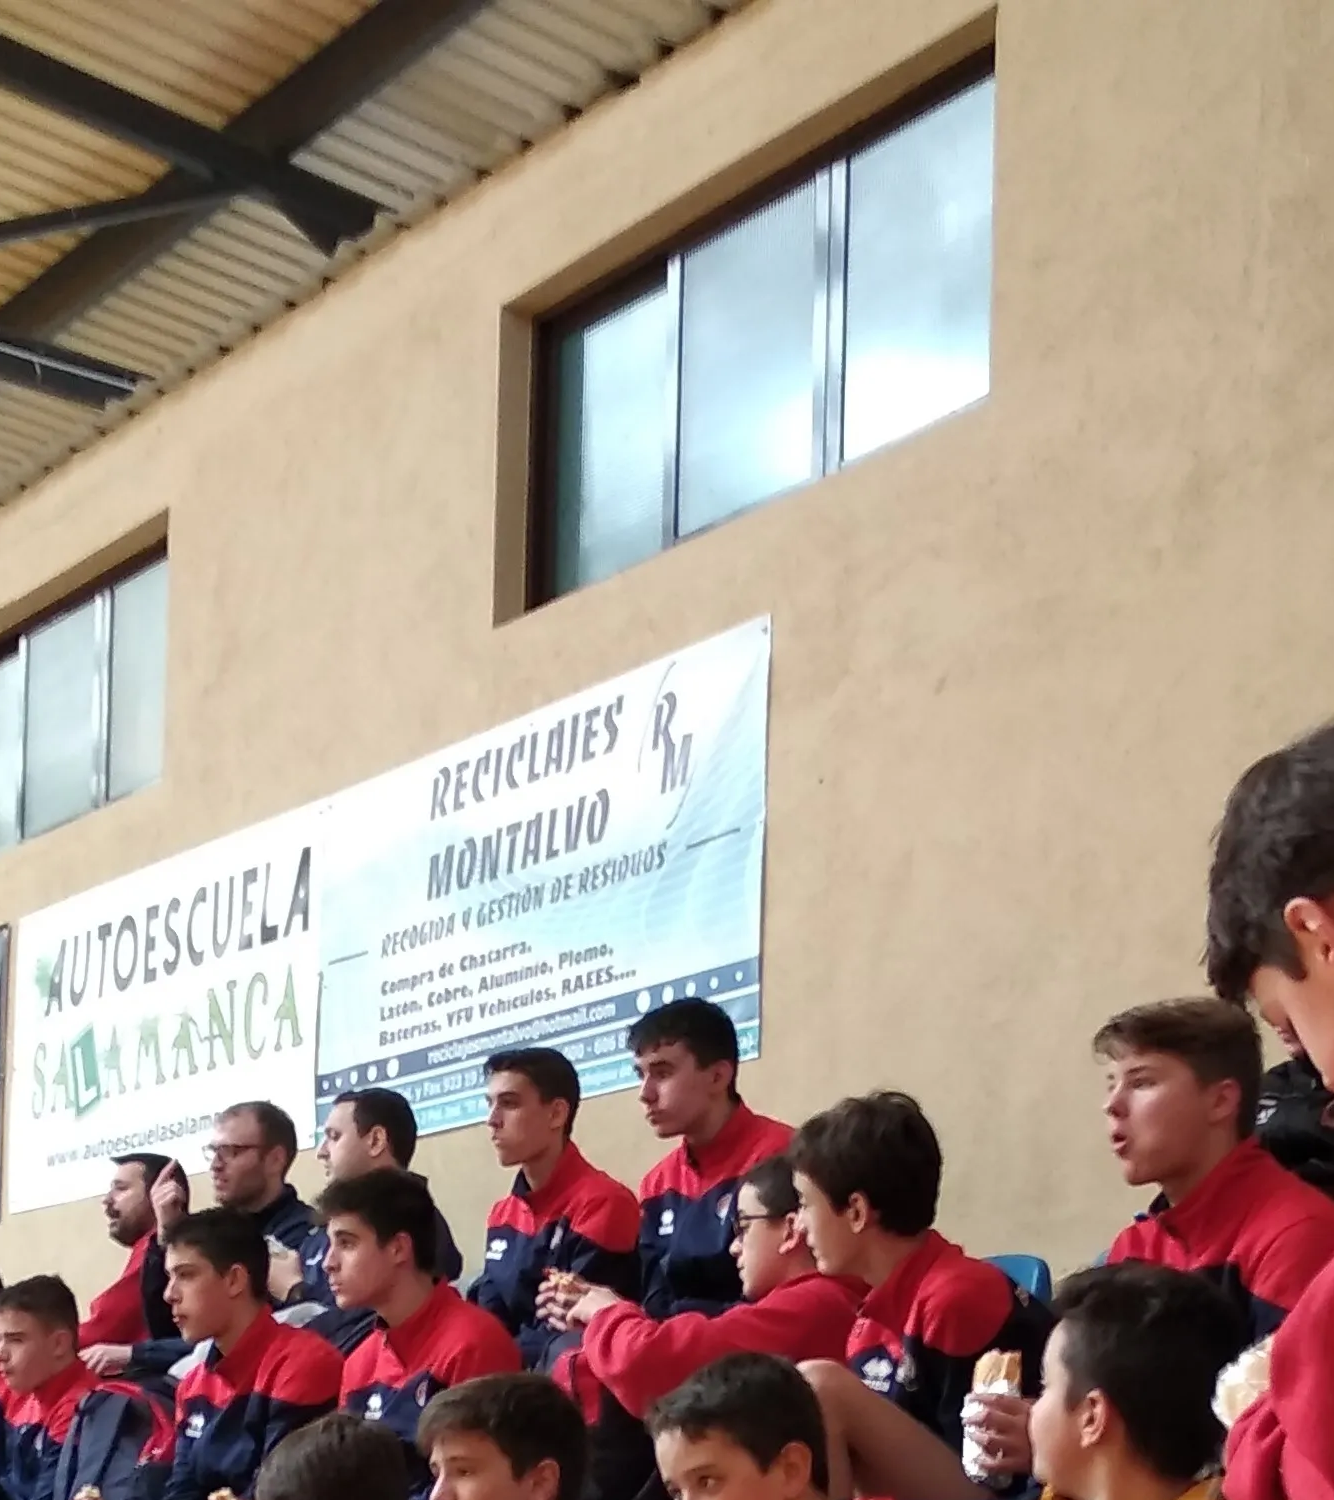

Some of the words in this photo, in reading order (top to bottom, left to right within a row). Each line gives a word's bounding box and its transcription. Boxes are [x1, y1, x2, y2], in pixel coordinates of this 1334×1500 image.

[430, 694, 624, 821] RECICLAJES
[381, 912, 456, 958] RECOGIDA
[462, 906, 472, 931] Y
[549, 873, 573, 904] DE
[578, 838, 667, 895] RESIDUOS
[427, 788, 610, 901] MONTALVO
[44, 847, 312, 1016] AUTOESCUELA
[380, 969, 434, 997] Compra
[438, 962, 454, 979] de
[32, 963, 304, 1119] SALAMANCA
[447, 1006, 473, 1027] VFU
